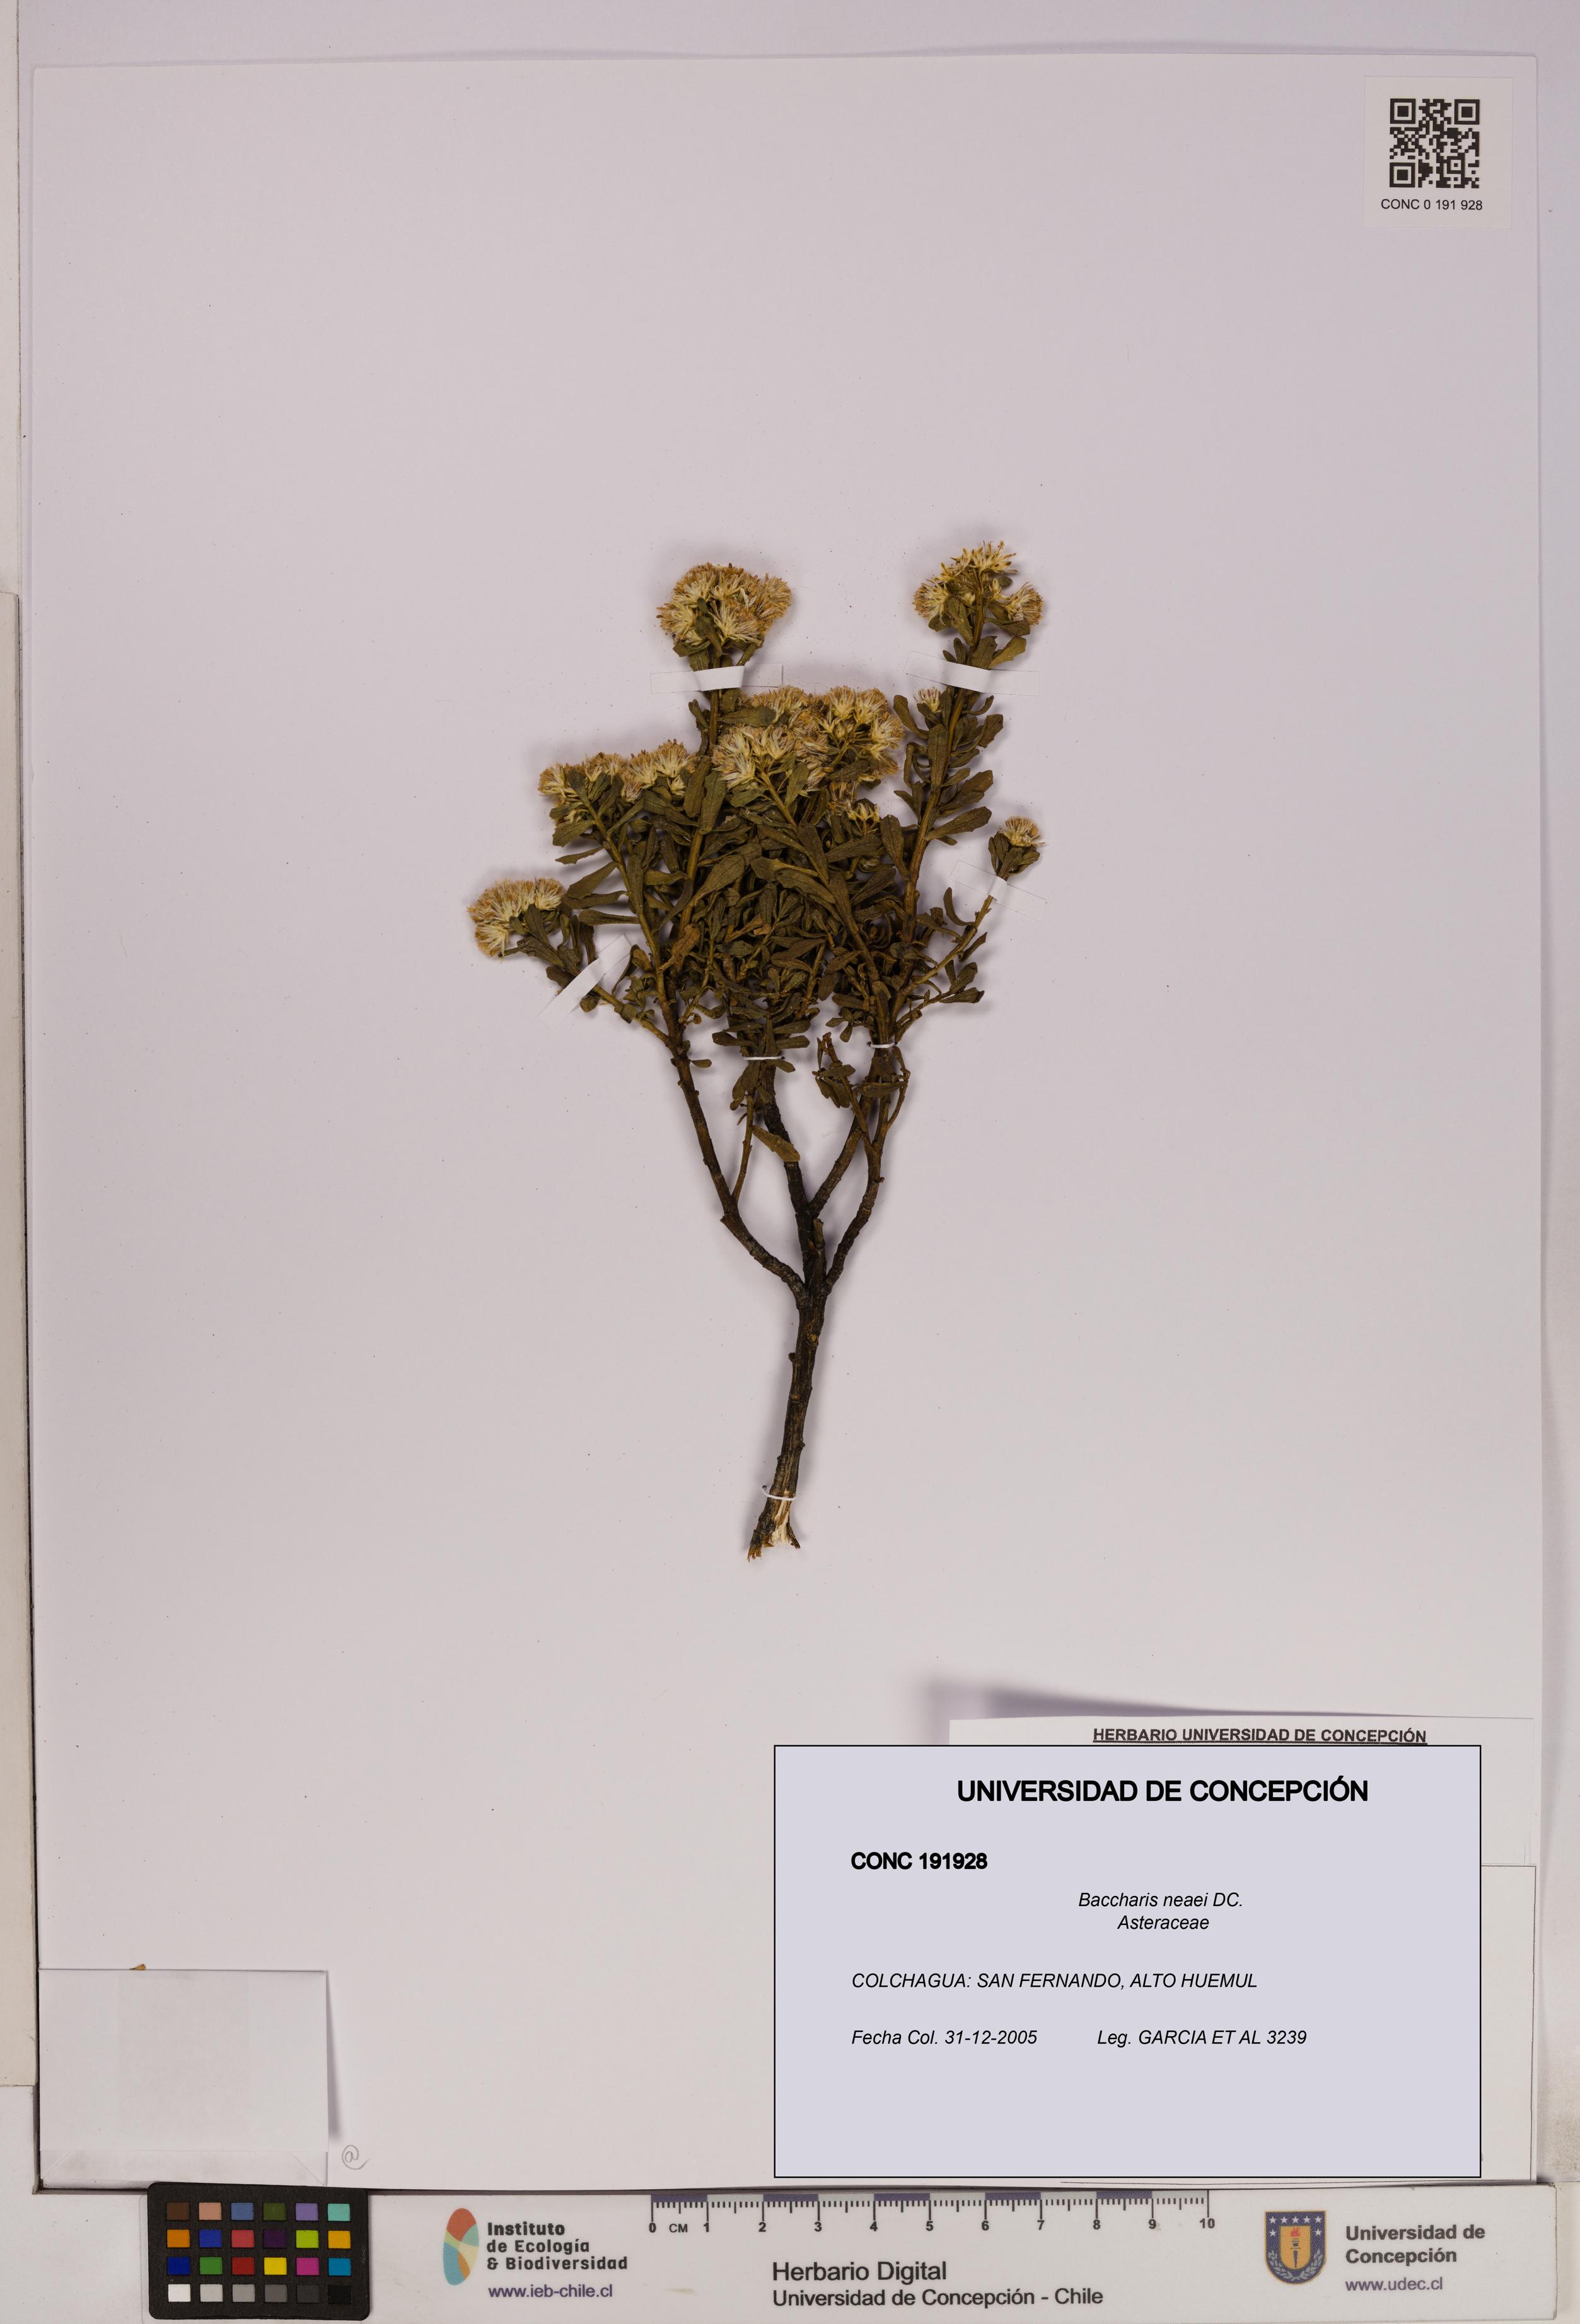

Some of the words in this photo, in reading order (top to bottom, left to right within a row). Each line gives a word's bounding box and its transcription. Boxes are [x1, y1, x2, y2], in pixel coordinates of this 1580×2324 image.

[1381, 199, 1420, 210] CONC
[1424, 199, 1431, 210] 0
[1436, 199, 1456, 211] 191
[1460, 200, 1483, 211] 928
[1093, 1728, 1178, 1741] HERBARIO
[1182, 1728, 1290, 1742] UNIVERSIDAD
[1294, 1729, 1316, 1742] DE
[1321, 1728, 1427, 1743] CONCEPCIÓN
[487, 2221, 566, 2236] Instituto
[649, 2222, 656, 2233] 0
[669, 2223, 688, 2233] CM
[703, 2222, 709, 2233] 1
[758, 2222, 767, 2232] 2
[814, 2221, 822, 2232] 3
[869, 2221, 878, 2231] 4
[926, 2221, 934, 2231] 5
[981, 2220, 989, 2231] 6
[1037, 2219, 1045, 2230] 7
[1093, 2219, 1101, 2230] 8
[1148, 2218, 1156, 2229] 9
[1199, 2218, 1216, 2229] 10
[1346, 2224, 1457, 2241] Universidad
[1462, 2224, 1485, 2240] de
[486, 2239, 508, 2253] de
[514, 2239, 590, 2255] Ecología
[487, 2257, 499, 2270] &
[506, 2255, 628, 2270] Biodiversidad
[1345, 2247, 1457, 2267] Concepción
[772, 2261, 869, 2281] Herbario
[878, 2261, 946, 2286] Digital
[488, 2284, 613, 2298] www.ieb-chile.cl
[1345, 2276, 1443, 2291] www.udec.cl
[773, 2289, 886, 2306] Universidad
[892, 2289, 916, 2306] de
[922, 2288, 1035, 2310] Concepción
[1054, 2287, 1103, 2304] Chile
